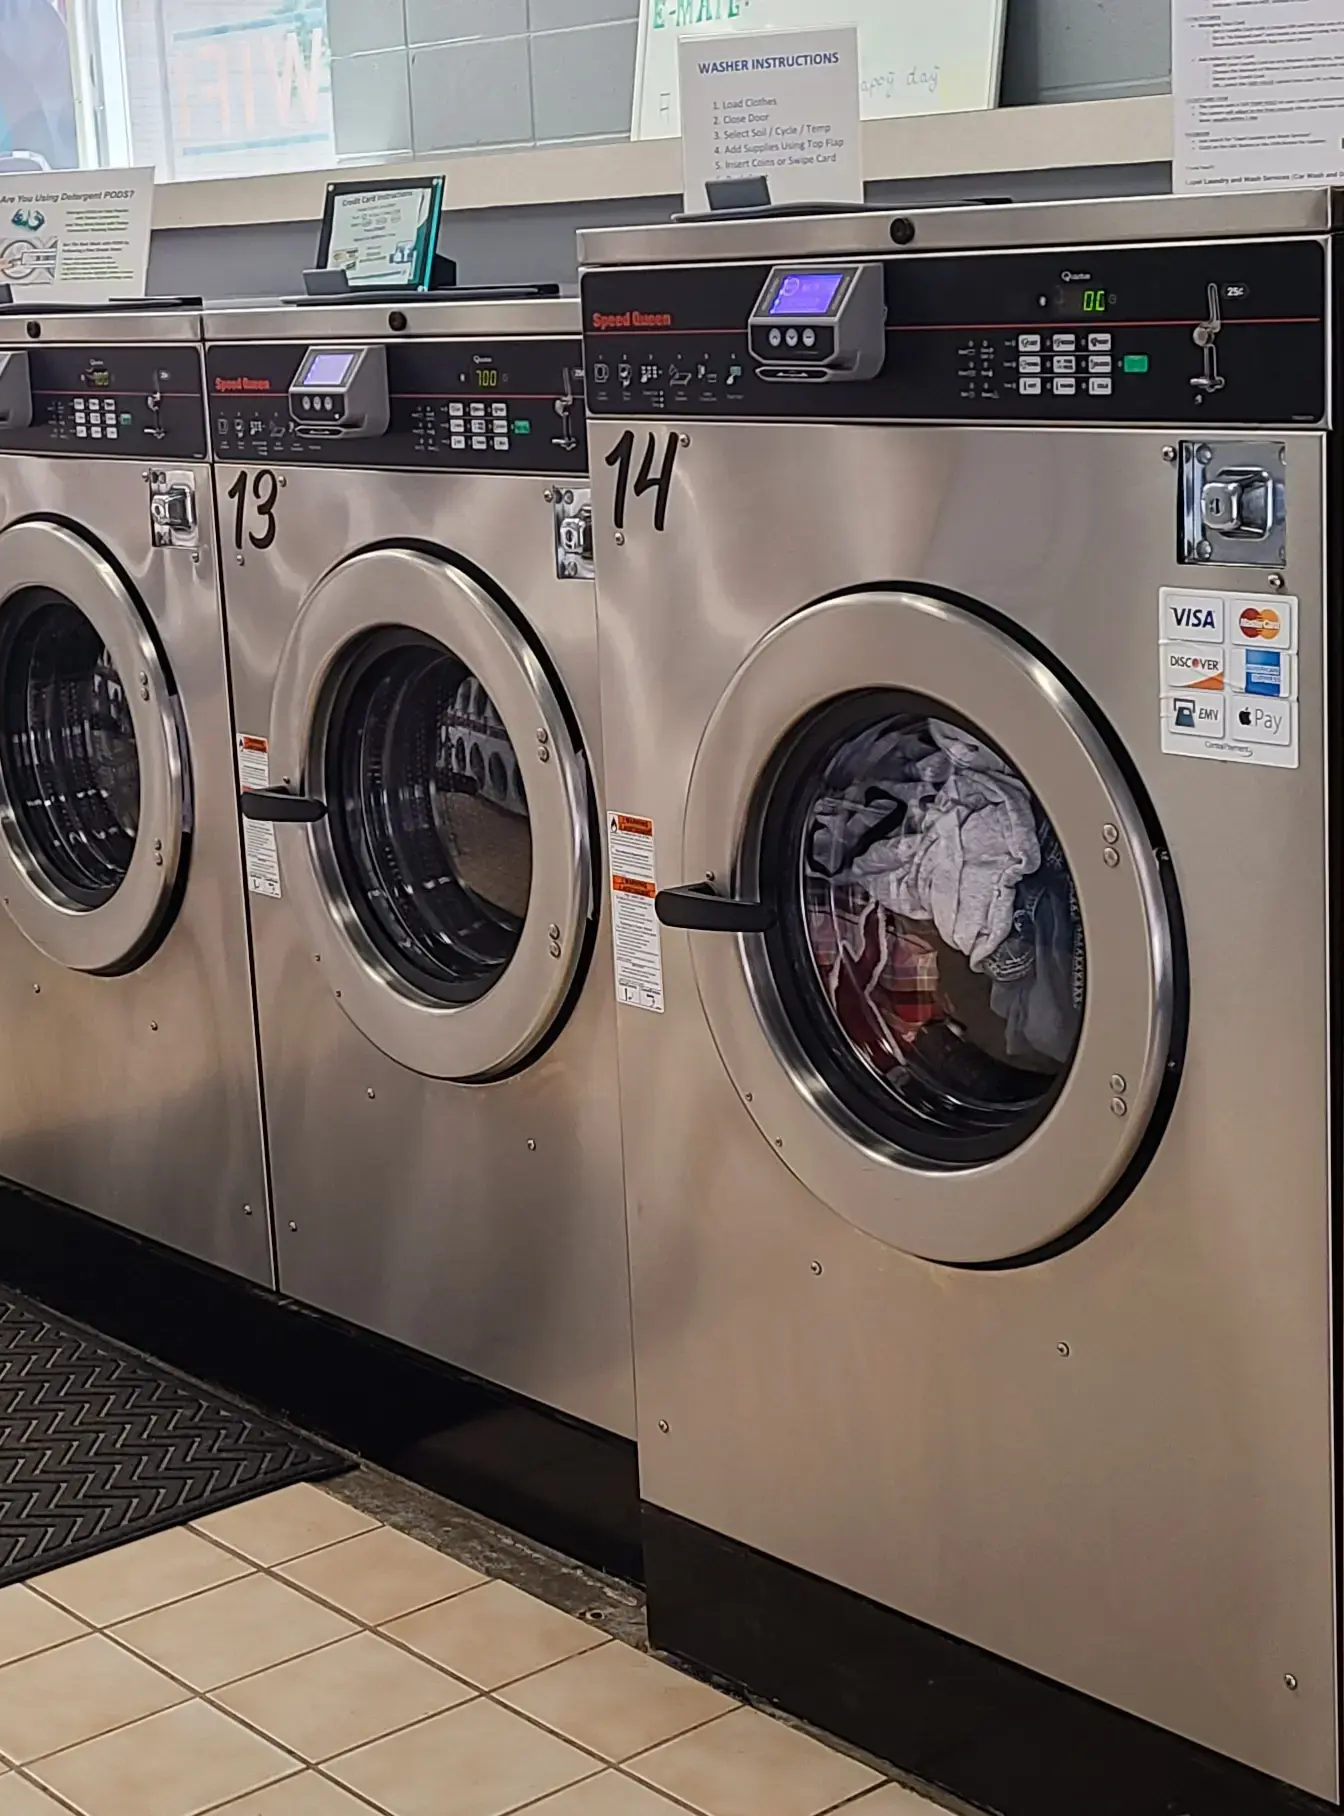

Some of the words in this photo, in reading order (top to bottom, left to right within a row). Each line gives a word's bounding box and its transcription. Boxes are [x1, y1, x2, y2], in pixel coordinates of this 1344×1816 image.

[698, 58, 749, 75] WASHER
[751, 52, 839, 70] INSTRUCTIONS
[723, 100, 744, 110] Load
[745, 97, 777, 108] Clothes
[723, 115, 746, 125] Close
[748, 113, 769, 123] Door
[724, 129, 749, 139] Select
[751, 127, 767, 138] Soil
[775, 126, 797, 137] Cycle
[806, 124, 831, 134] Temp
[724, 144, 742, 154] Add
[744, 142, 779, 154] Supplies
[781, 140, 805, 151] Using
[807, 139, 823, 149] Top
[825, 138, 844, 149] Flap
[725, 159, 750, 169] Insert
[751, 157, 775, 168] Coins
[777, 157, 787, 166] or
[788, 155, 814, 165] Swipe
[816, 153, 837, 163] Card
[17, 194, 32, 203] You
[35, 193, 58, 203] Using
[592, 312, 631, 329] Speed
[632, 311, 671, 327] Queen
[605, 430, 679, 531] 14
[227, 469, 278, 550] 13
[1169, 606, 1216, 629] VISA
[1170, 655, 1219, 670] DISCOVER
[1198, 707, 1219, 721] EMV
[1255, 709, 1283, 735] Pay
